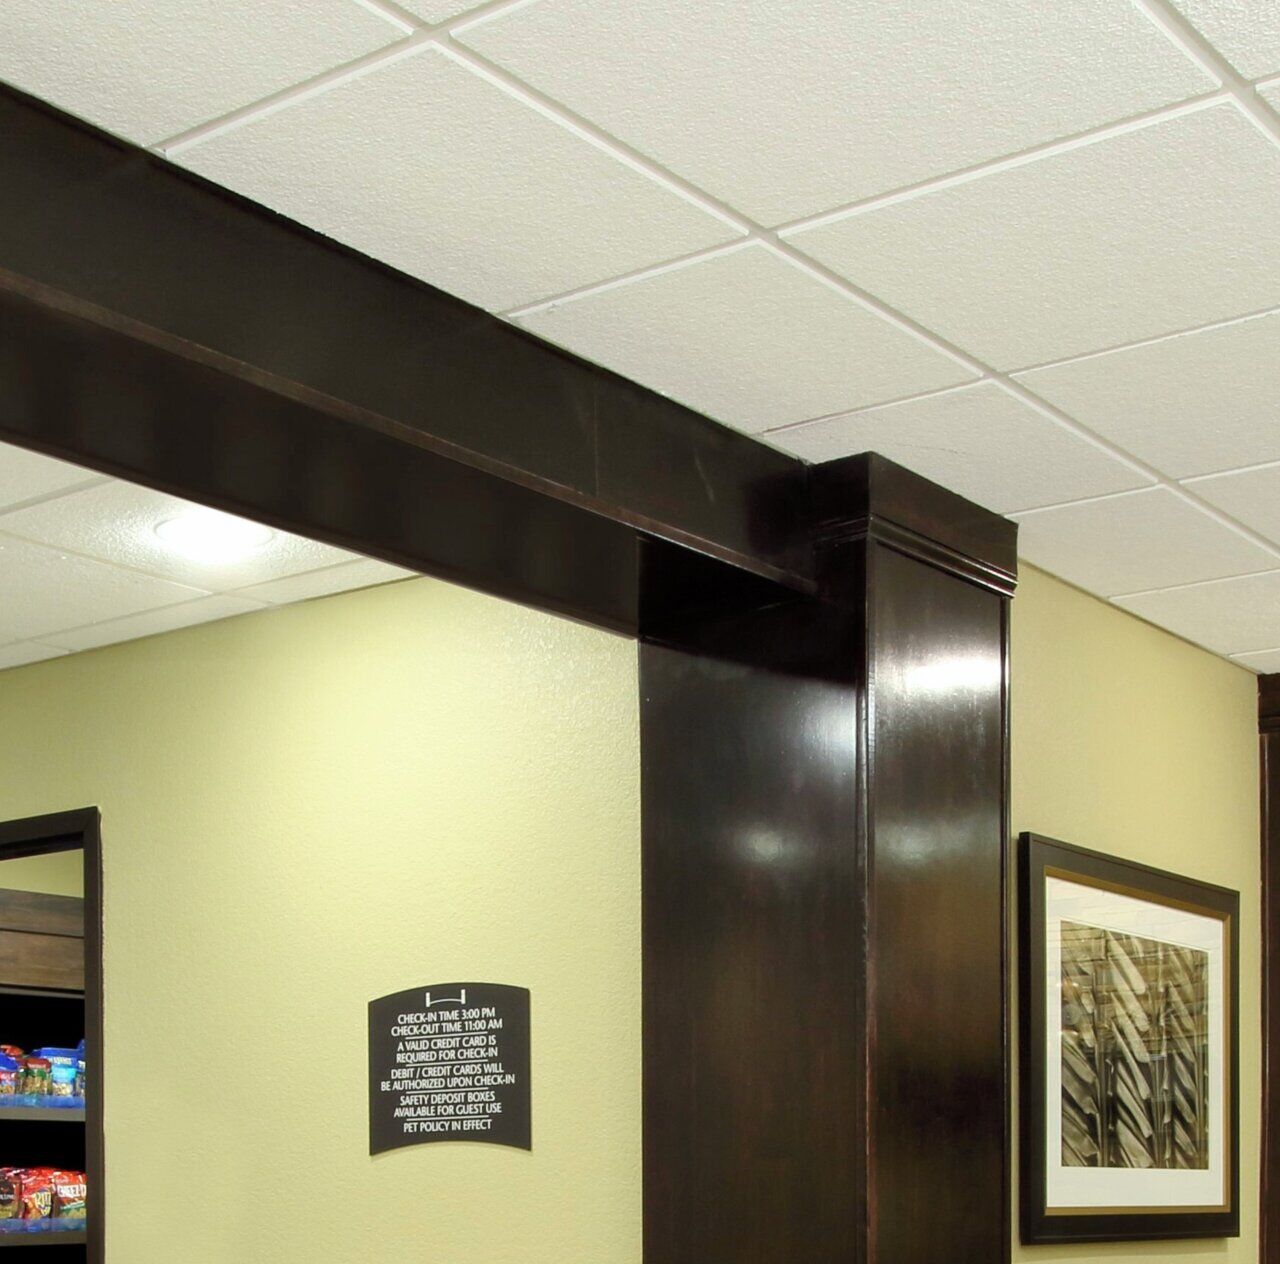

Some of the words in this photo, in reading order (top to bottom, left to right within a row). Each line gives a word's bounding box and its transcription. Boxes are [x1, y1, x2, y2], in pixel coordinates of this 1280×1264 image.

[398, 1011, 437, 1024] CHECK-IN
[439, 1010, 459, 1021] TIME
[461, 1009, 480, 1019] 3:00
[482, 1007, 495, 1018] PM
[391, 1022, 439, 1036] CHECK-OUT
[441, 1022, 462, 1032] TIME
[465, 1020, 486, 1031] 11:00
[488, 1019, 502, 1029] AM
[398, 1041, 404, 1051] A
[405, 1040, 429, 1050] VALID
[431, 1038, 460, 1048] CREDIT
[462, 1037, 486, 1047] CARD
[488, 1035, 496, 1045] IS
[397, 1051, 436, 1063] REQUIRED
[438, 1050, 455, 1060] FOR
[458, 1047, 497, 1059] CHECK-IN
[391, 1068, 415, 1079] DEBIT
[422, 1066, 451, 1077] CREDIT
[453, 1064, 481, 1075] CARDS
[484, 1063, 504, 1073] WILL
[381, 1081, 391, 1091] BE
[392, 1078, 445, 1091] AUTHORIZED
[447, 1077, 472, 1088] UPON
[474, 1074, 515, 1086] CHECK-IN
[400, 1095, 429, 1106] SAFETY
[431, 1093, 465, 1104] DEPOSIT
[468, 1091, 495, 1102] BOXES
[394, 1105, 435, 1118] AVAILABLE
[437, 1105, 454, 1115] FOR
[456, 1103, 484, 1114] GUEST
[486, 1103, 502, 1113] USE
[404, 1122, 417, 1132] PET
[420, 1121, 449, 1132] POLICY
[452, 1121, 461, 1130] IN
[463, 1119, 492, 1130] EFFECT
